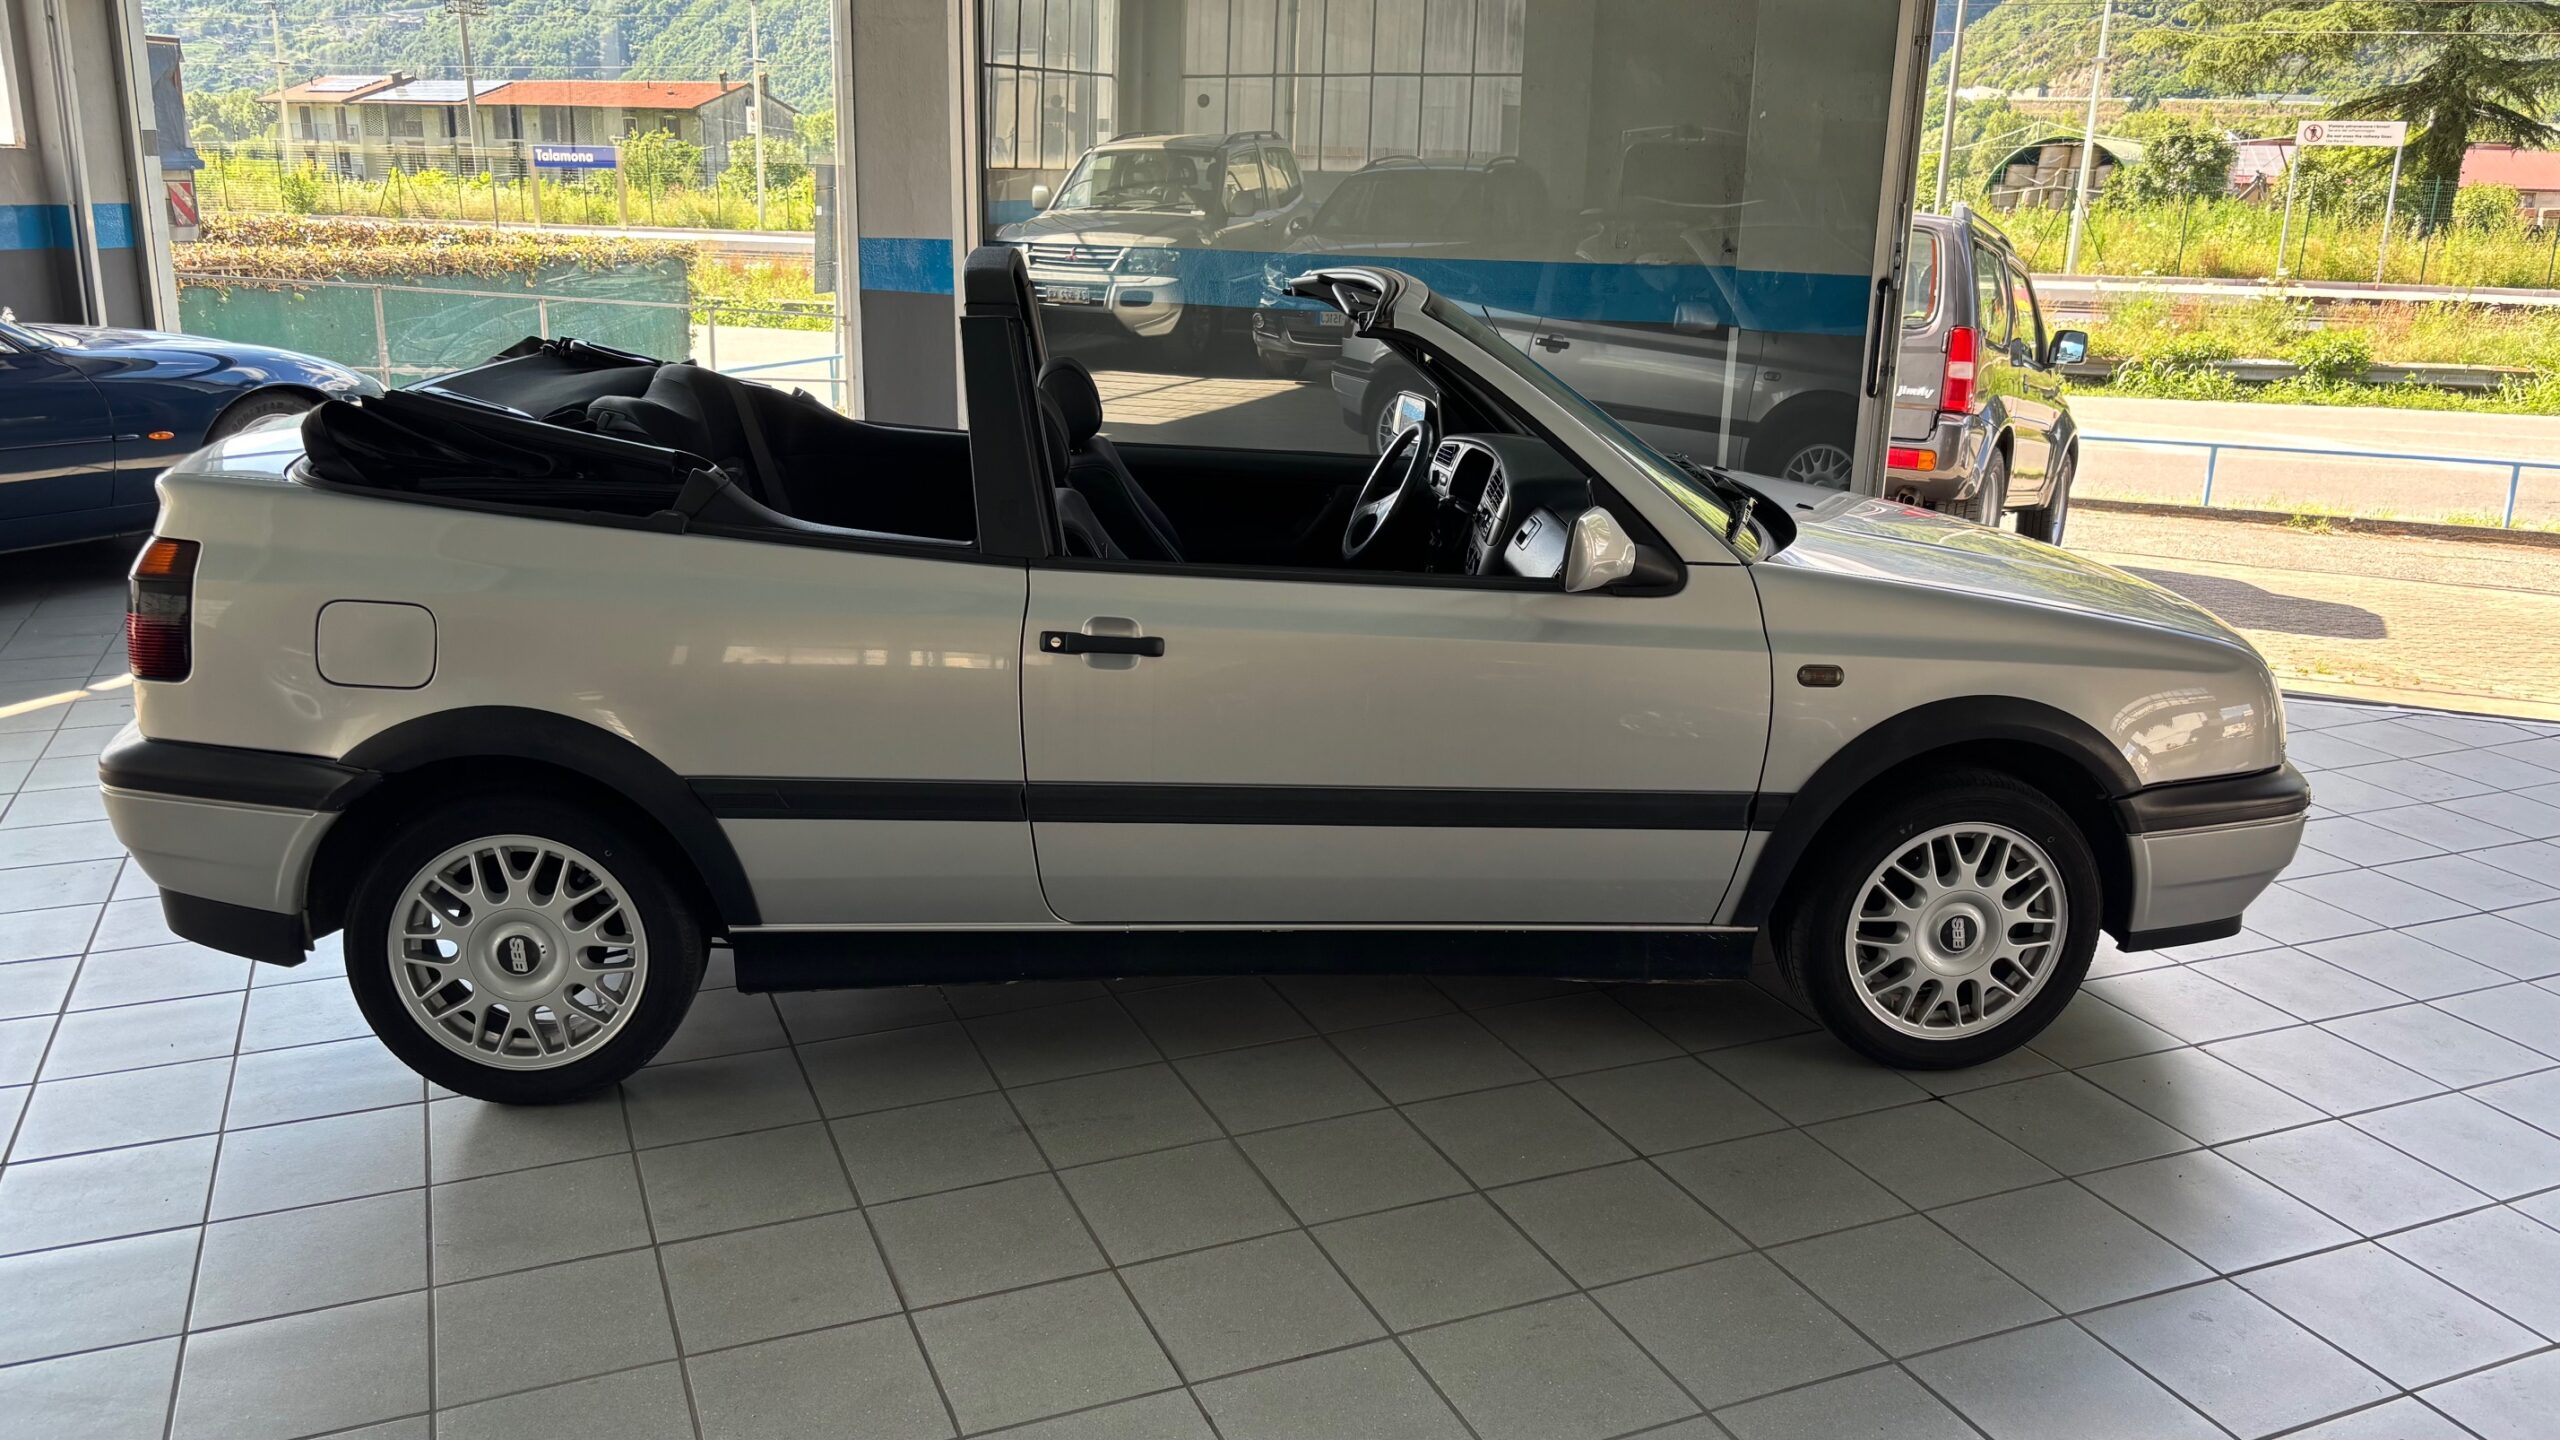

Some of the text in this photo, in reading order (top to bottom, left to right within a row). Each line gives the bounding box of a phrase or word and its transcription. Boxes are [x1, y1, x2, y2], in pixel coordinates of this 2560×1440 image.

[535, 148, 594, 163] Talamona
[1951, 917, 1966, 949] BBS
[509, 937, 529, 973] BBS
